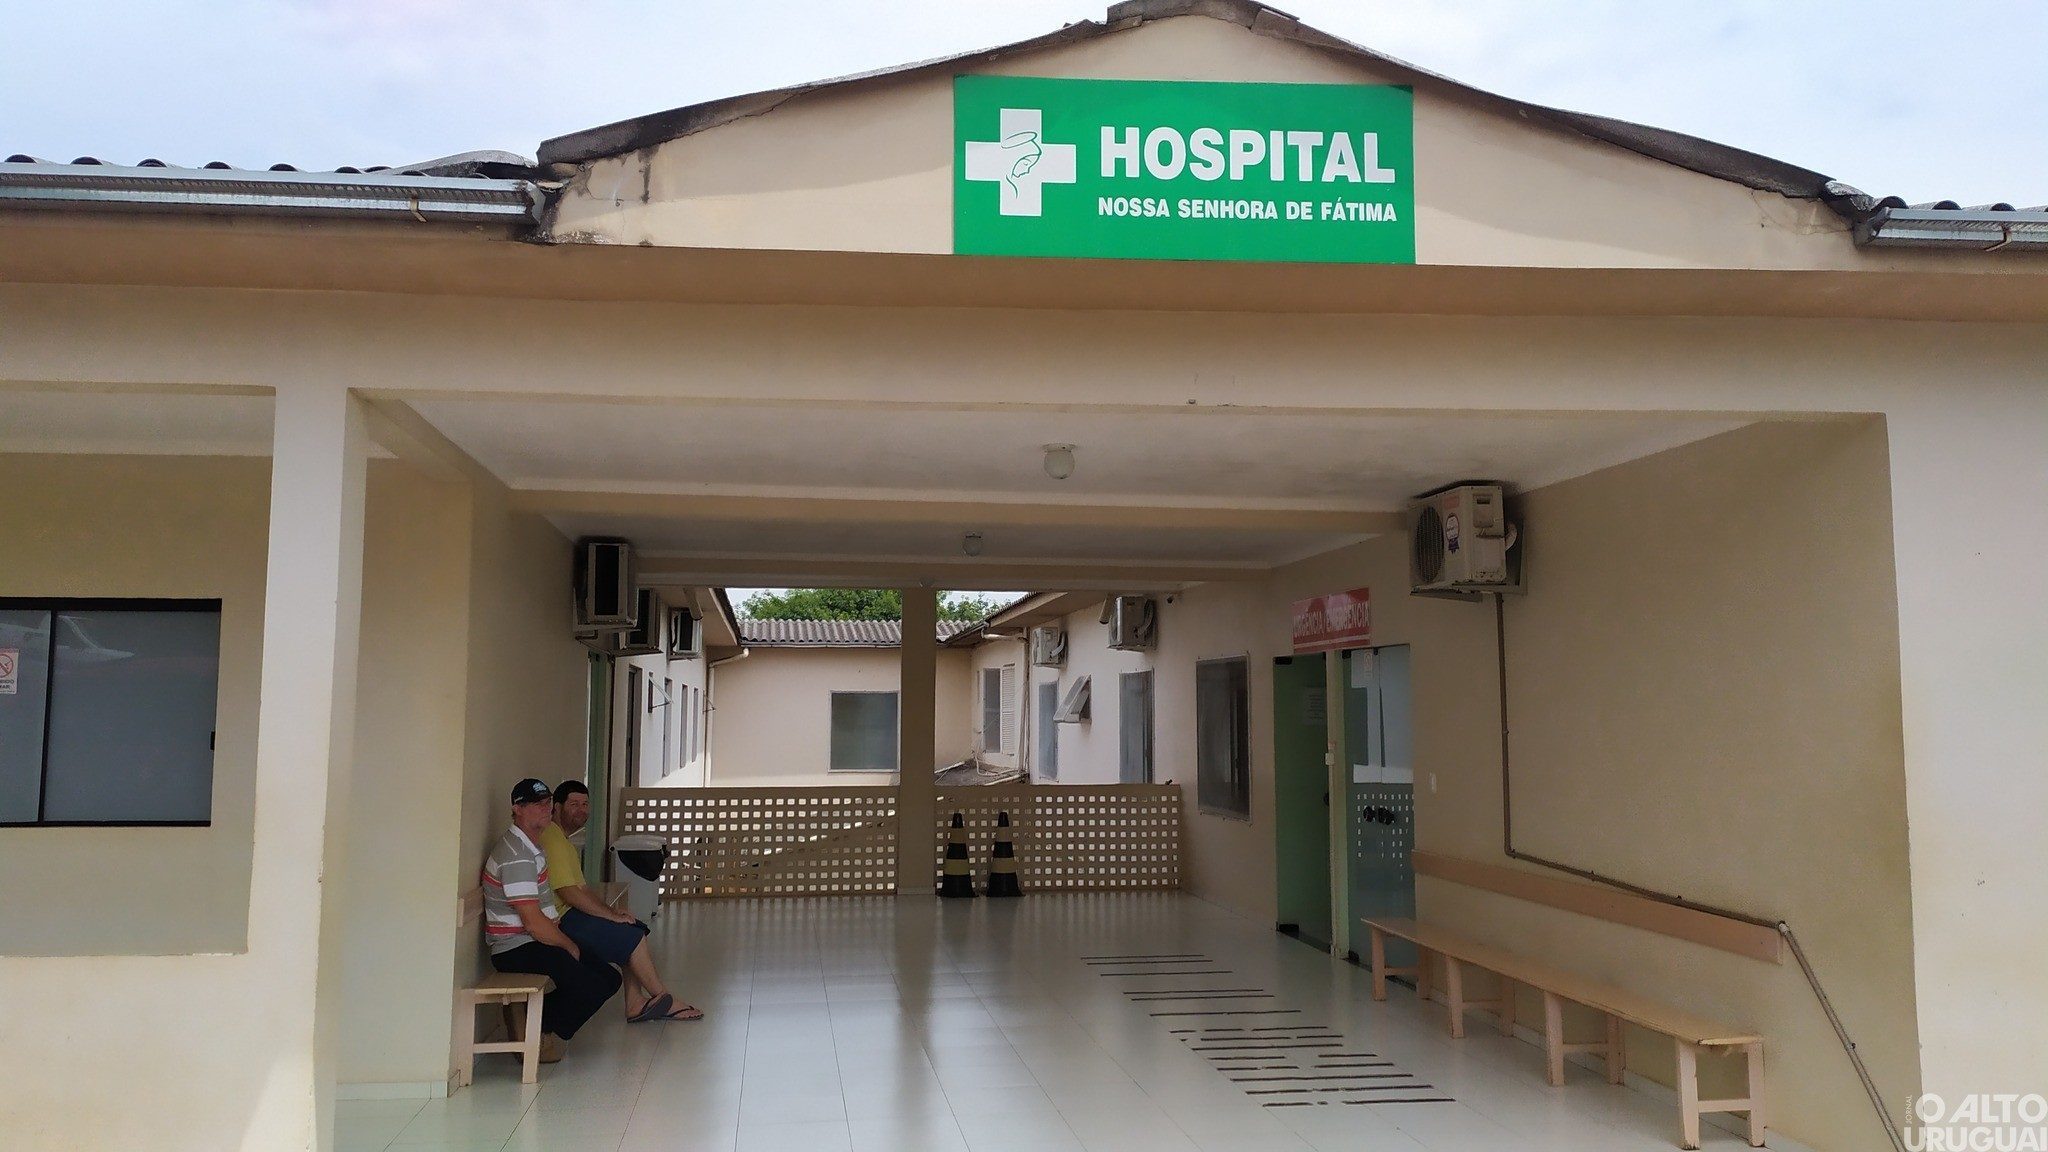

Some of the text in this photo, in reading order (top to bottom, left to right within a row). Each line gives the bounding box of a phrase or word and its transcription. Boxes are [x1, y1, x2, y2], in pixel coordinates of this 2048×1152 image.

[1101, 126, 1396, 183] HOSPITAL
[1098, 197, 1397, 222] NOSSA SENHORA DE FÁTIMA
